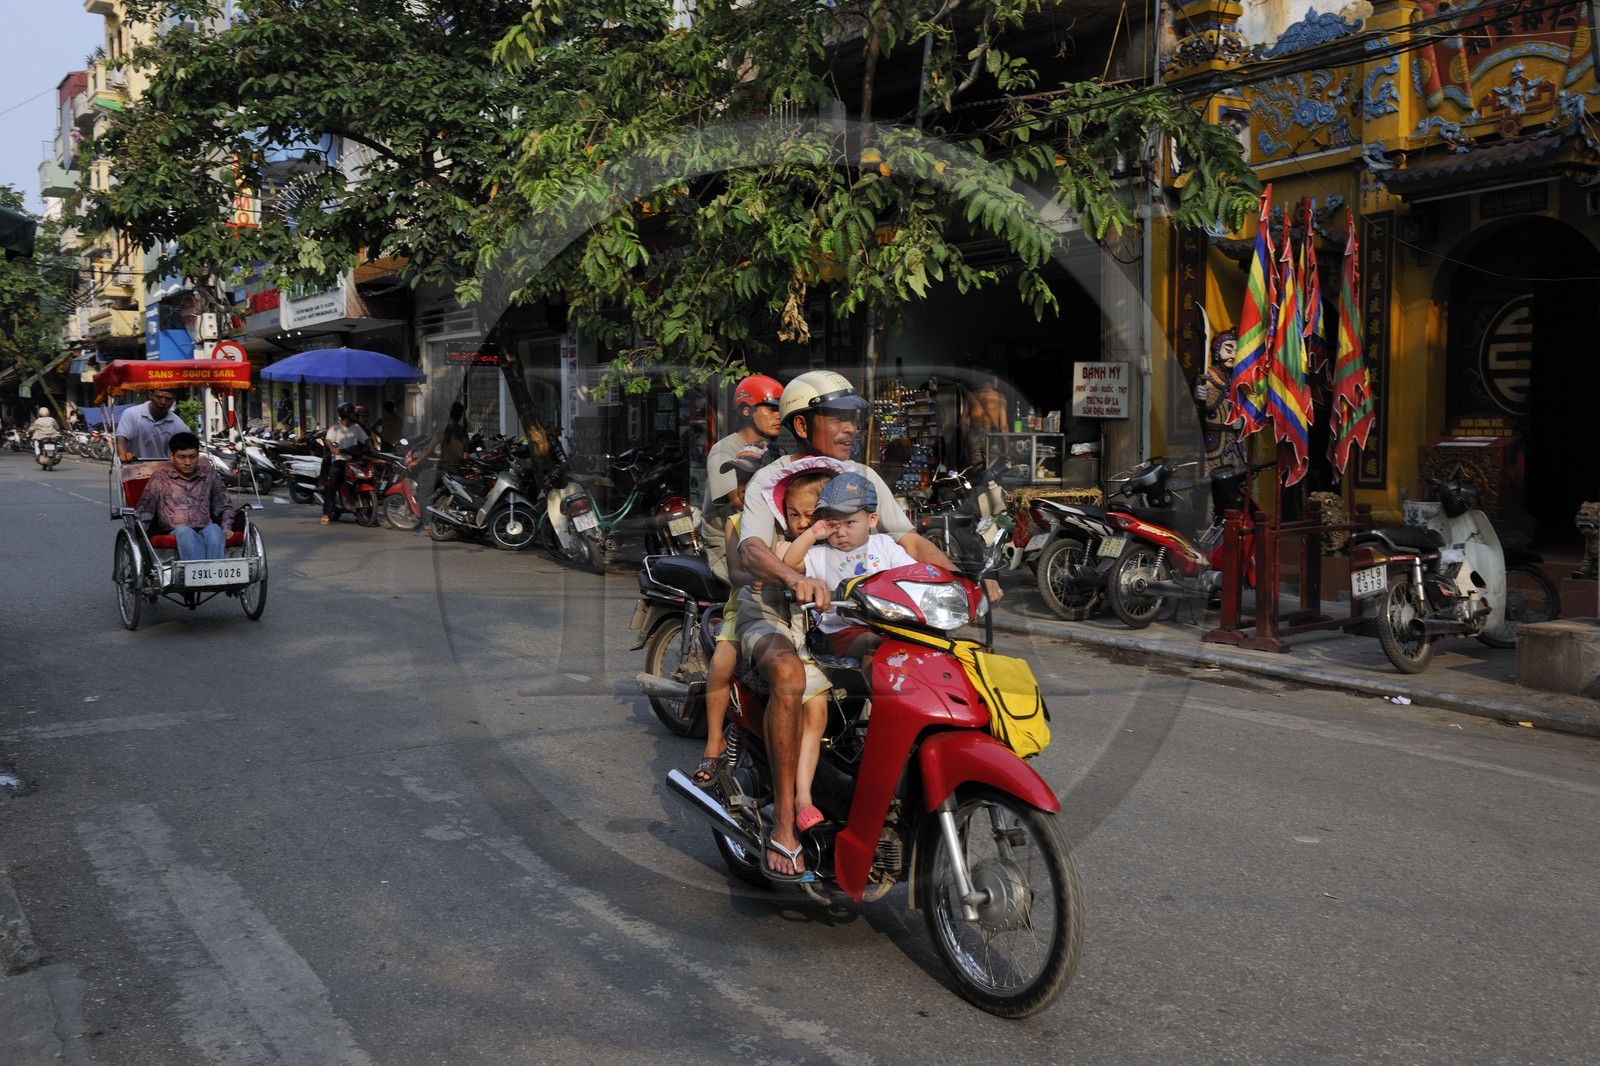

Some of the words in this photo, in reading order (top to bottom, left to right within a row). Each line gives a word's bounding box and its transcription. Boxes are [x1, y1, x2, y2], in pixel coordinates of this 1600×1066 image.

[148, 370, 174, 379] SANS
[182, 369, 211, 378] SOUCI
[213, 369, 236, 378] SARL
[1082, 364, 1106, 380] BÁNH
[192, 568, 241, 580] 29XL-0026
